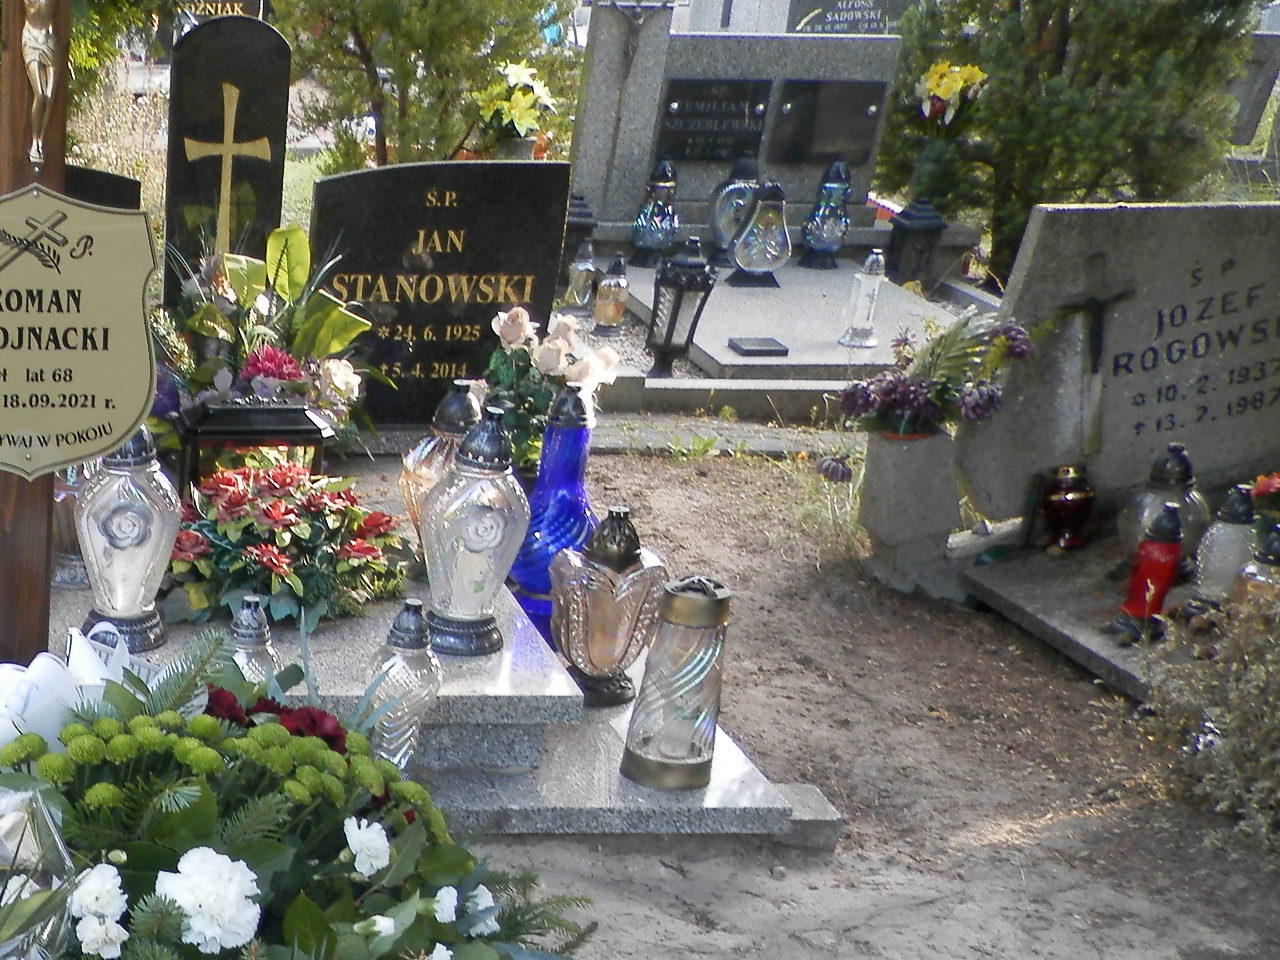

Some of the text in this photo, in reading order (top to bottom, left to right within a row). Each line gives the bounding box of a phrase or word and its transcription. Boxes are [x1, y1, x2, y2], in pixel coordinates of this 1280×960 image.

[825, 9, 882, 22] SADOWSKI
[412, 229, 466, 253] JAN
[332, 273, 535, 303] STANOWSKI
[445, 324, 481, 341] 1925
[1112, 316, 1280, 377] ROGOWS
[26, 368, 45, 382] lat
[52, 368, 74, 382] 68
[430, 362, 467, 378] 2014
[3, 394, 96, 408] 18.09.2021
[104, 398, 116, 409] r.
[37, 435, 51, 447] W
[56, 421, 113, 447] POKOJU
